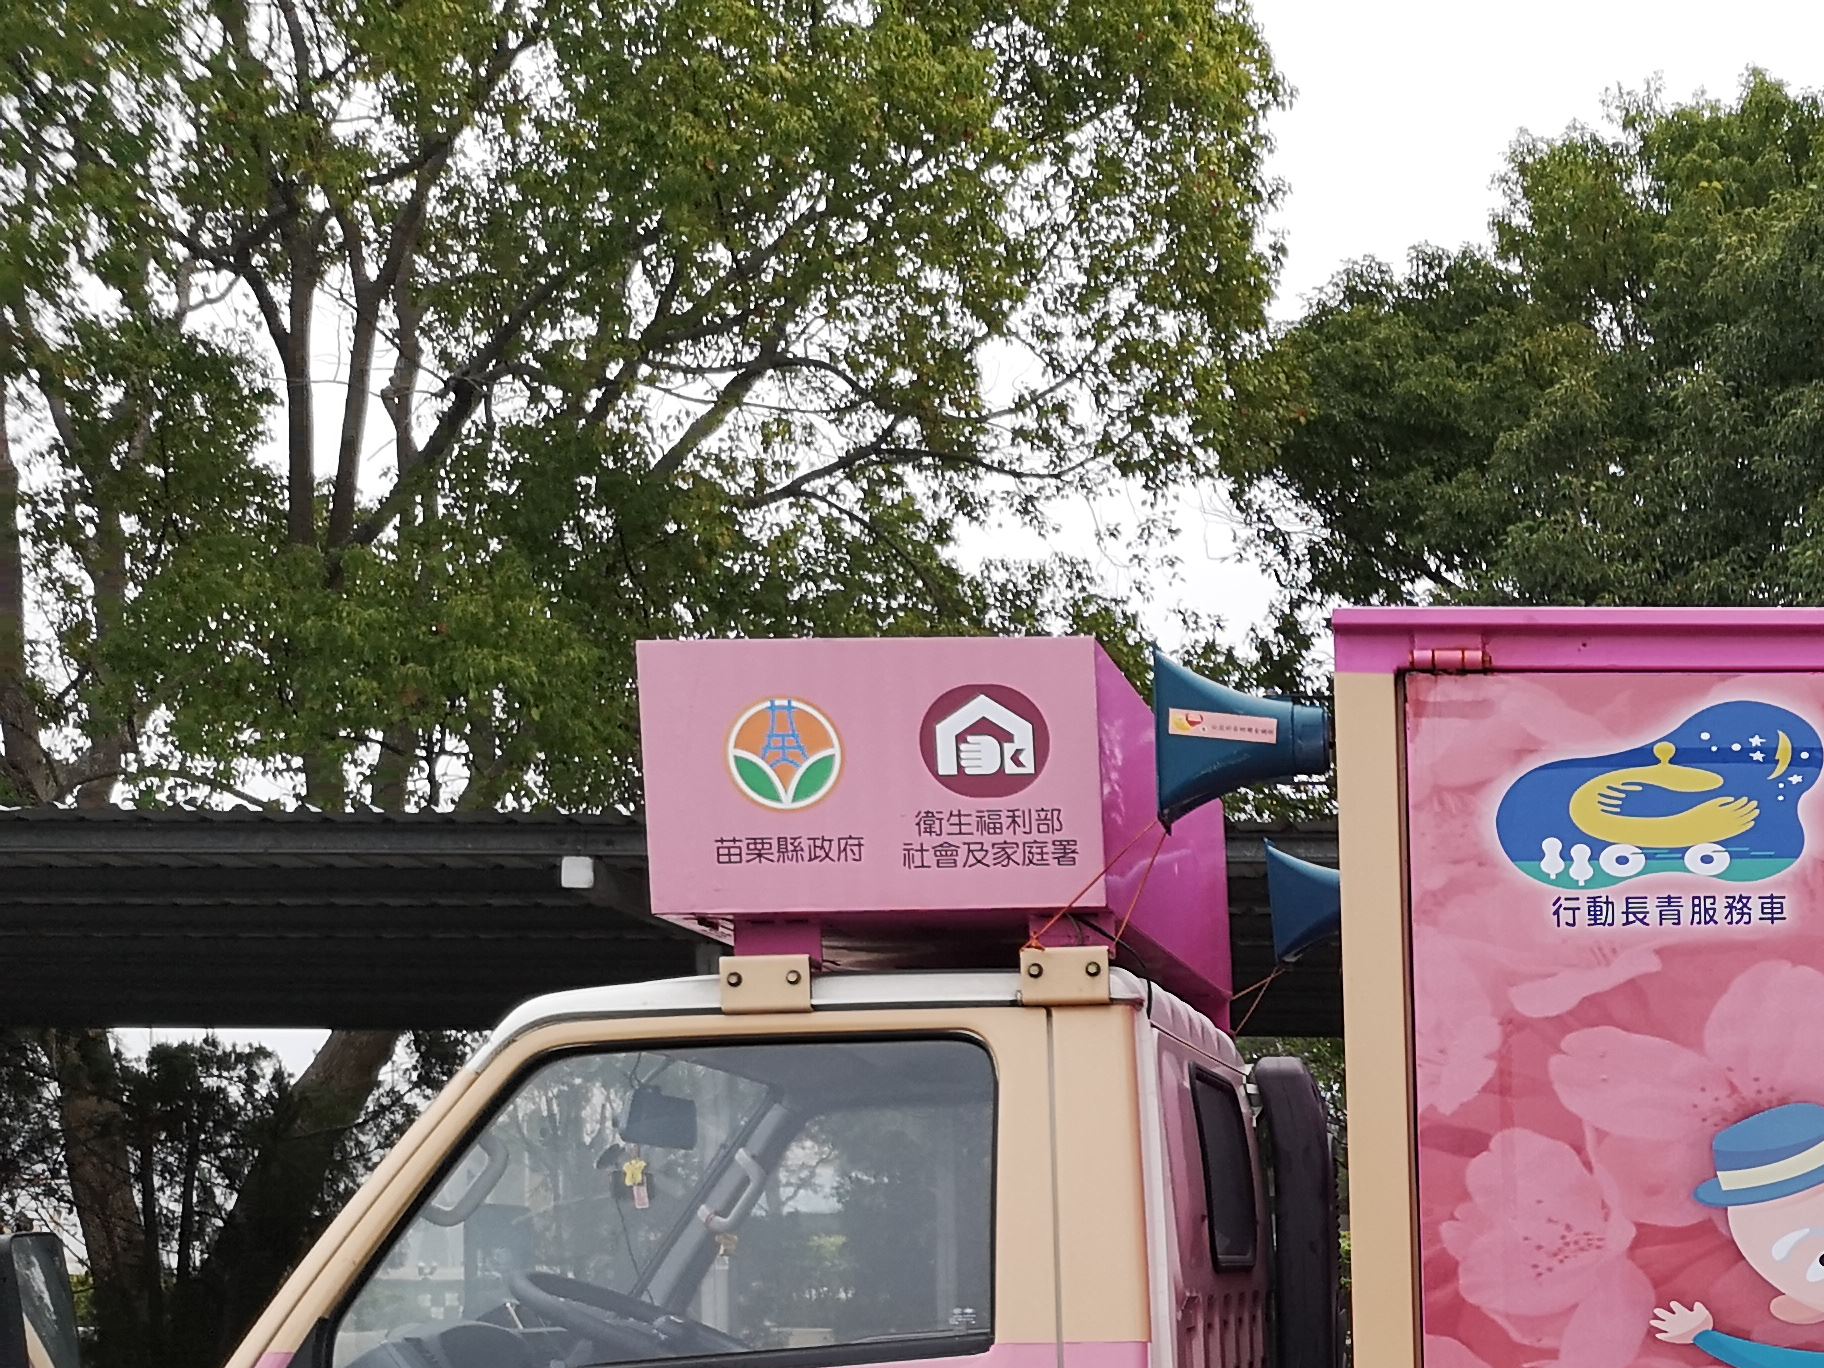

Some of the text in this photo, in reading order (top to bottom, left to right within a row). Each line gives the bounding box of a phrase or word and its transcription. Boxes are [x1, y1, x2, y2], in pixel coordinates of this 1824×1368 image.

[914, 808, 1063, 837] 衛生福利部
[714, 835, 864, 865] 苗栗縣政府
[902, 839, 1079, 869] 社會及家庭署
[1551, 893, 1787, 927] 行動長青服務車
